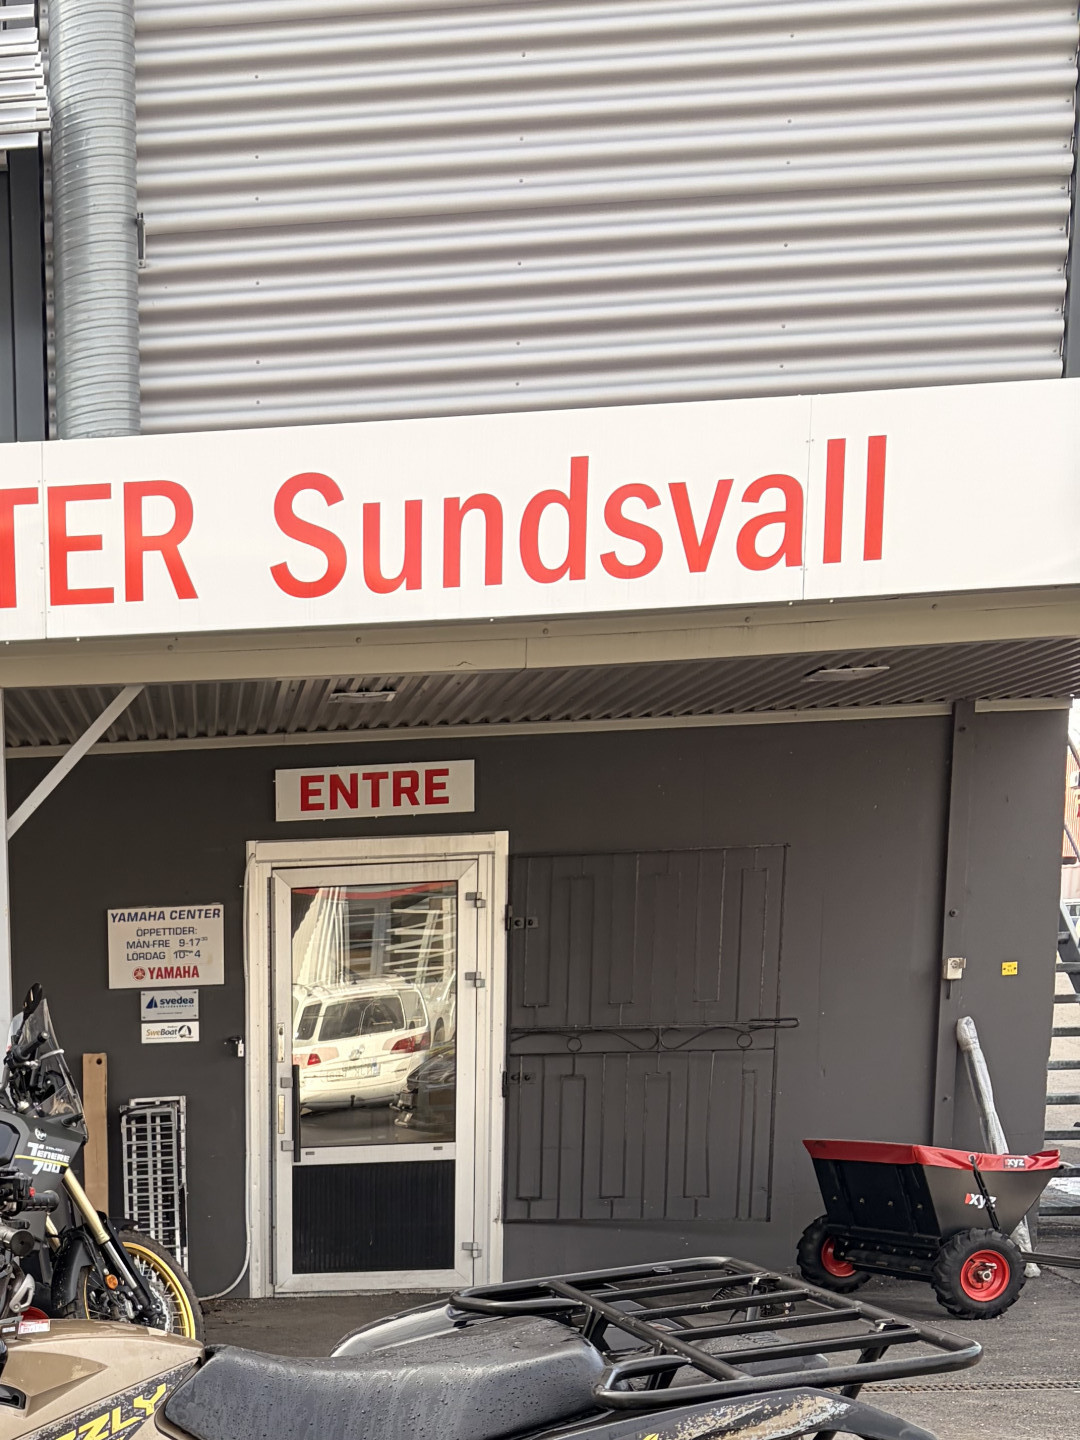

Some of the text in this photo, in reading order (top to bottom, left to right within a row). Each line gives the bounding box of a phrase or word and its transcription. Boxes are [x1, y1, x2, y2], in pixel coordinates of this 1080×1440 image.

[271, 435, 886, 598] Sundsvall
[301, 768, 450, 812] ENTRE
[111, 908, 221, 923] YAMAHA CENTER
[136, 926, 198, 937] ÖPPETTIDER:
[126, 938, 171, 949] MÅN-FRE
[148, 965, 200, 979] YAMAHA
[160, 996, 195, 1005] svedea
[146, 1028, 178, 1037] SweBoat
[31, 1160, 61, 1175] 700
